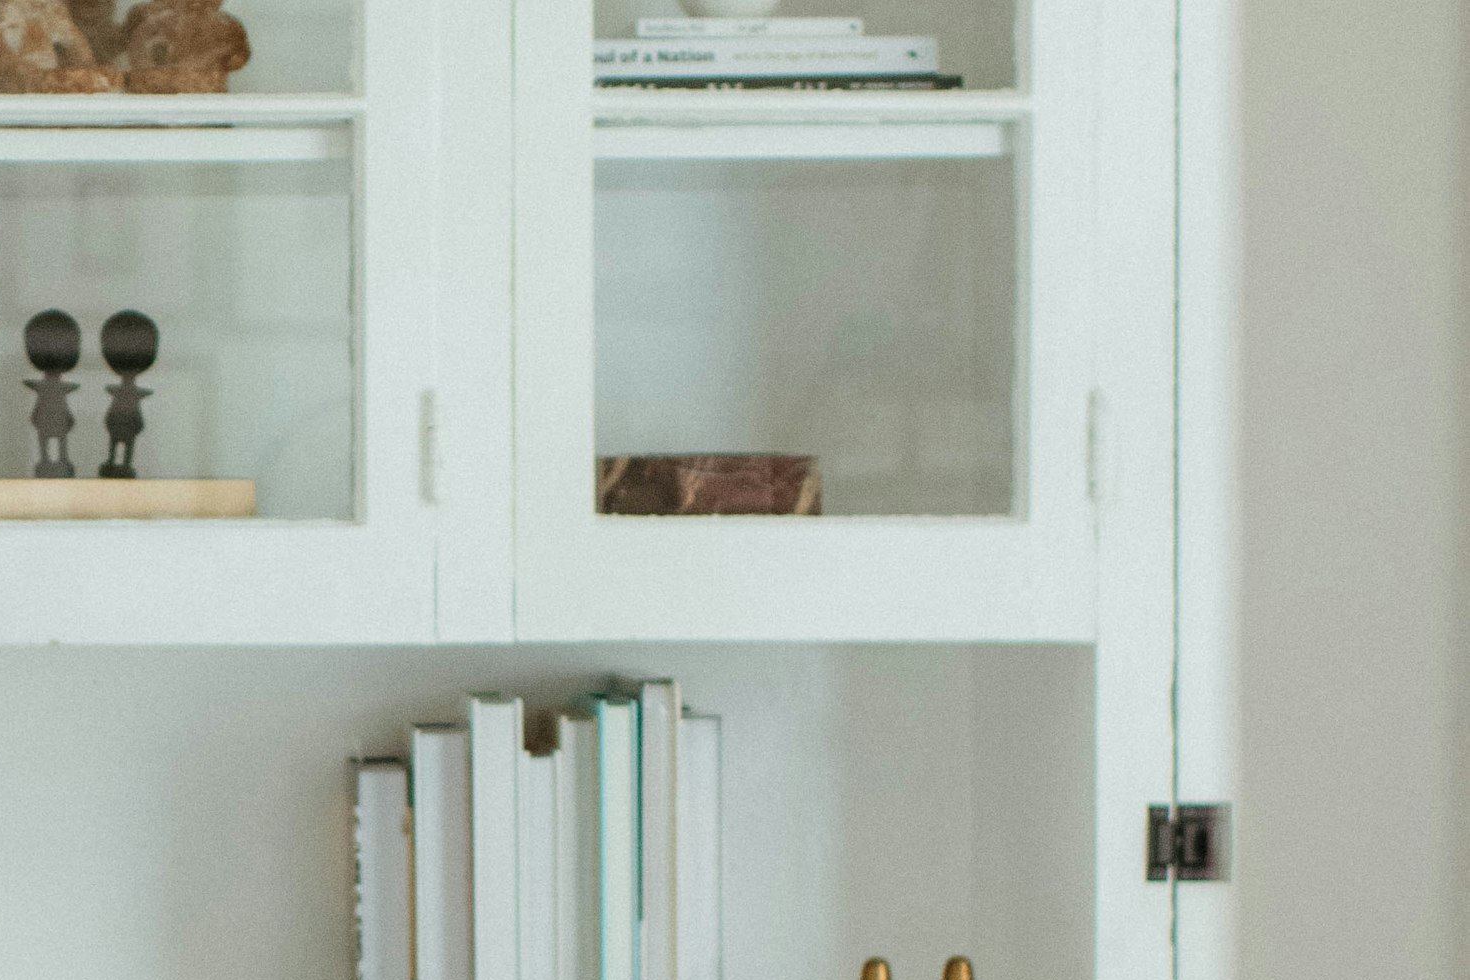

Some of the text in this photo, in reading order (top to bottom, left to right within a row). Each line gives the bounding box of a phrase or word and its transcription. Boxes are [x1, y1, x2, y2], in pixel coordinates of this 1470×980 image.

[593, 49, 715, 62] oul of a Nation
